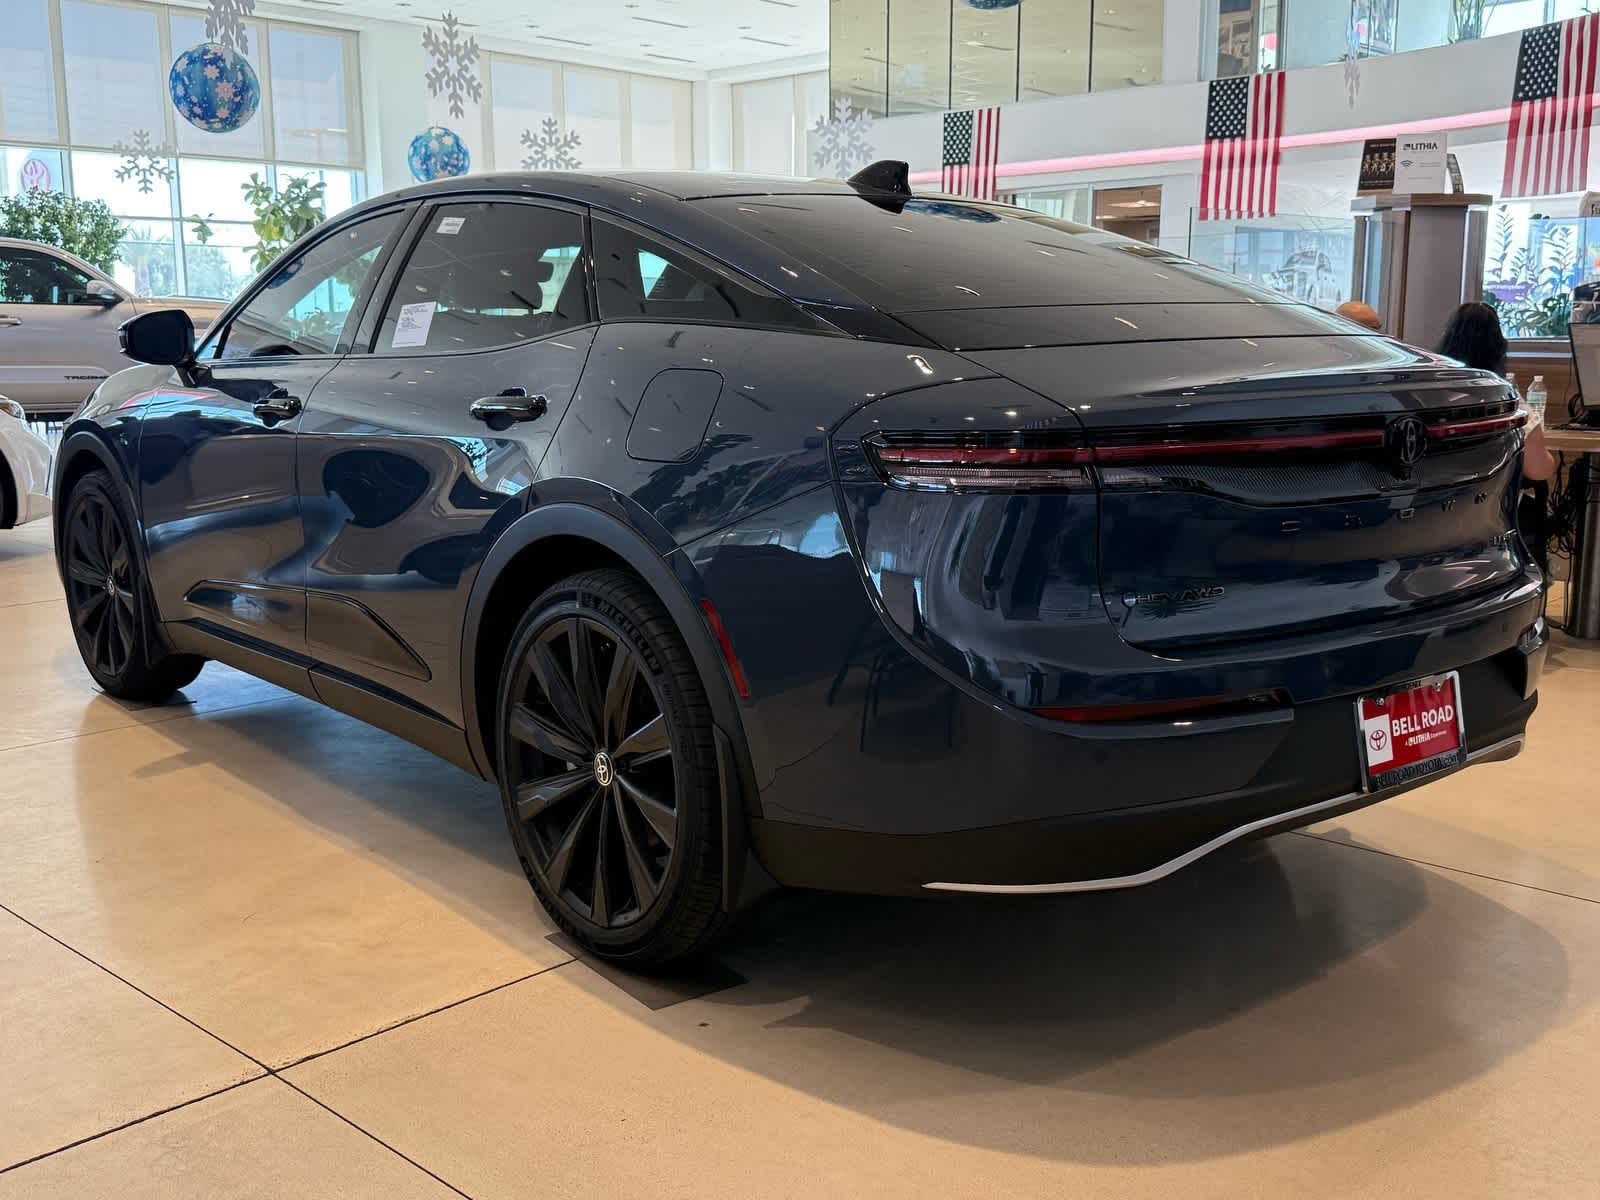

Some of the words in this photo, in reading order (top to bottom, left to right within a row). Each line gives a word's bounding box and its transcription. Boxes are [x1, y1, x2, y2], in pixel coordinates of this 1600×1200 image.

[1411, 142, 1438, 151] LITHIA
[599, 604, 665, 676] MICHELIN
[1392, 714, 1421, 737] BELL
[1421, 704, 1454, 729] ROAD
